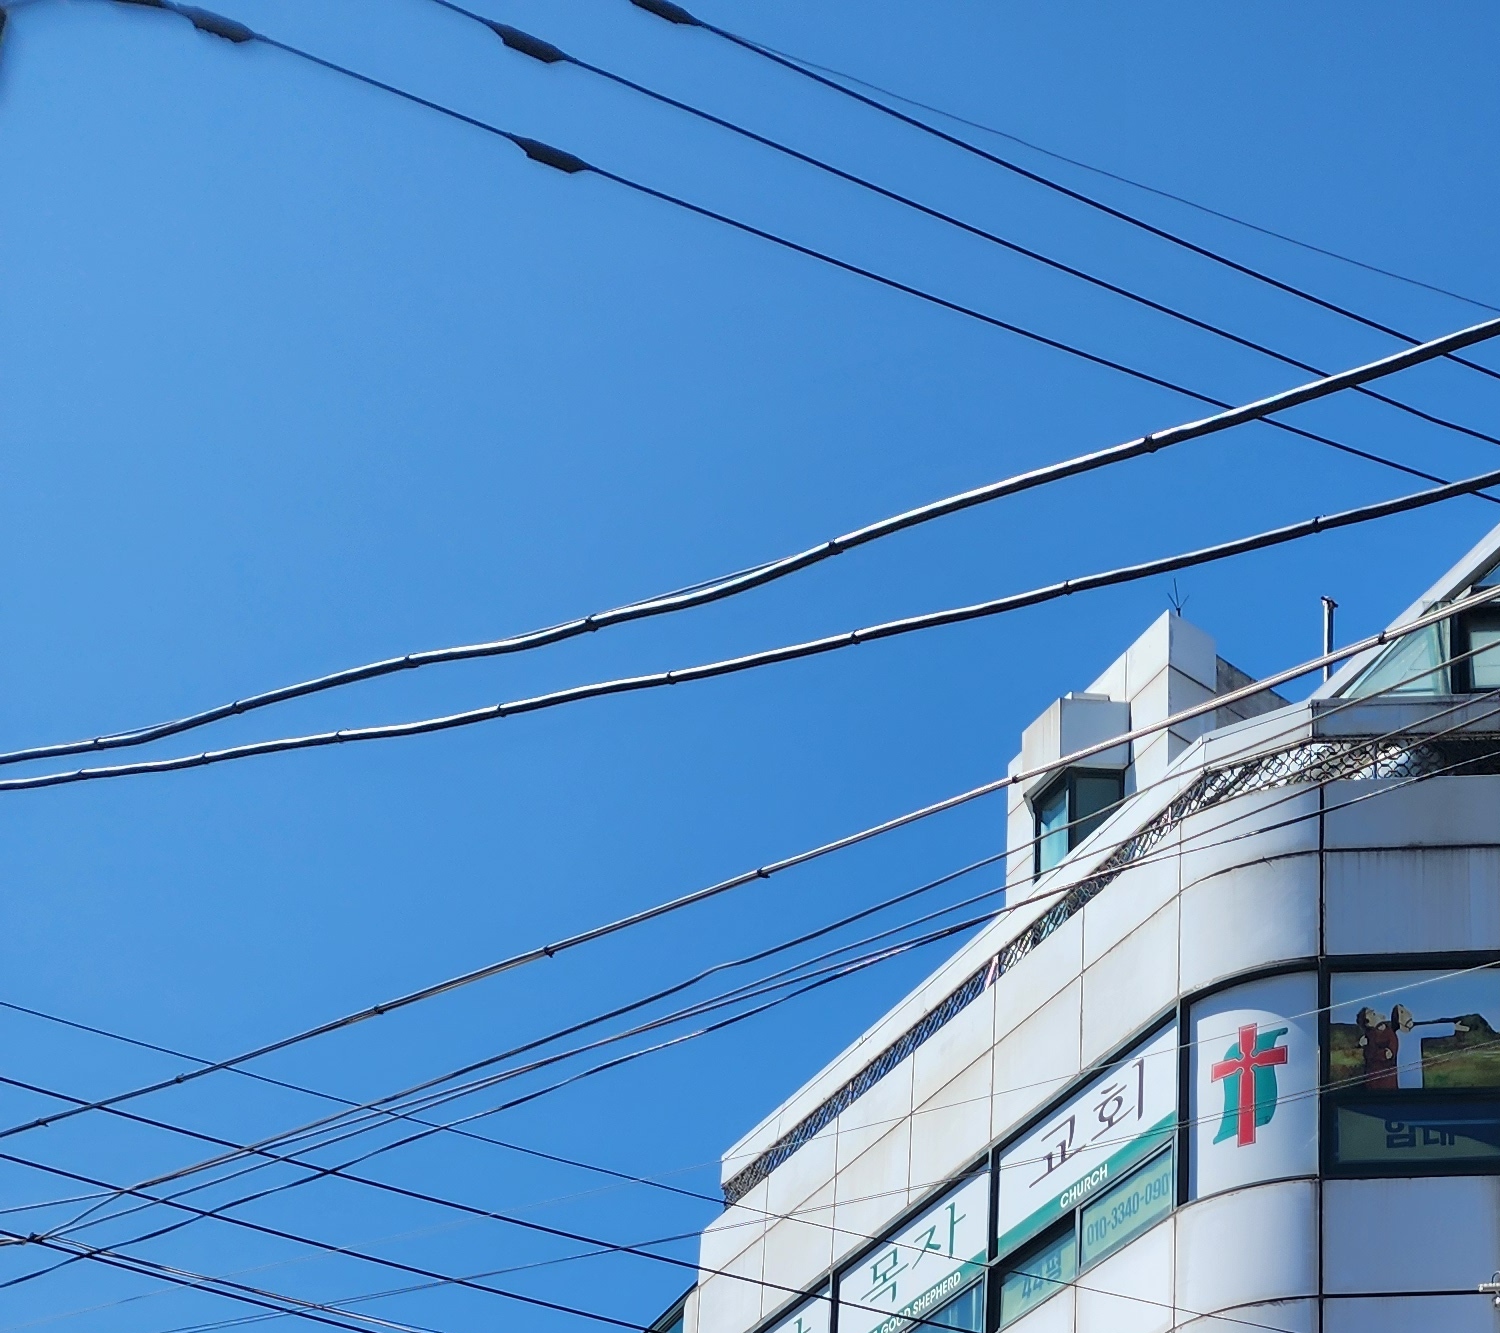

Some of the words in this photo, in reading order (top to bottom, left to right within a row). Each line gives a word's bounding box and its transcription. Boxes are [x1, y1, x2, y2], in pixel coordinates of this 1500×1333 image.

[861, 1201, 967, 1303] 목자
[1028, 1057, 1145, 1189] 교회
[1060, 1163, 1108, 1209] CHURCH
[913, 1271, 961, 1313] SHEPHERD
